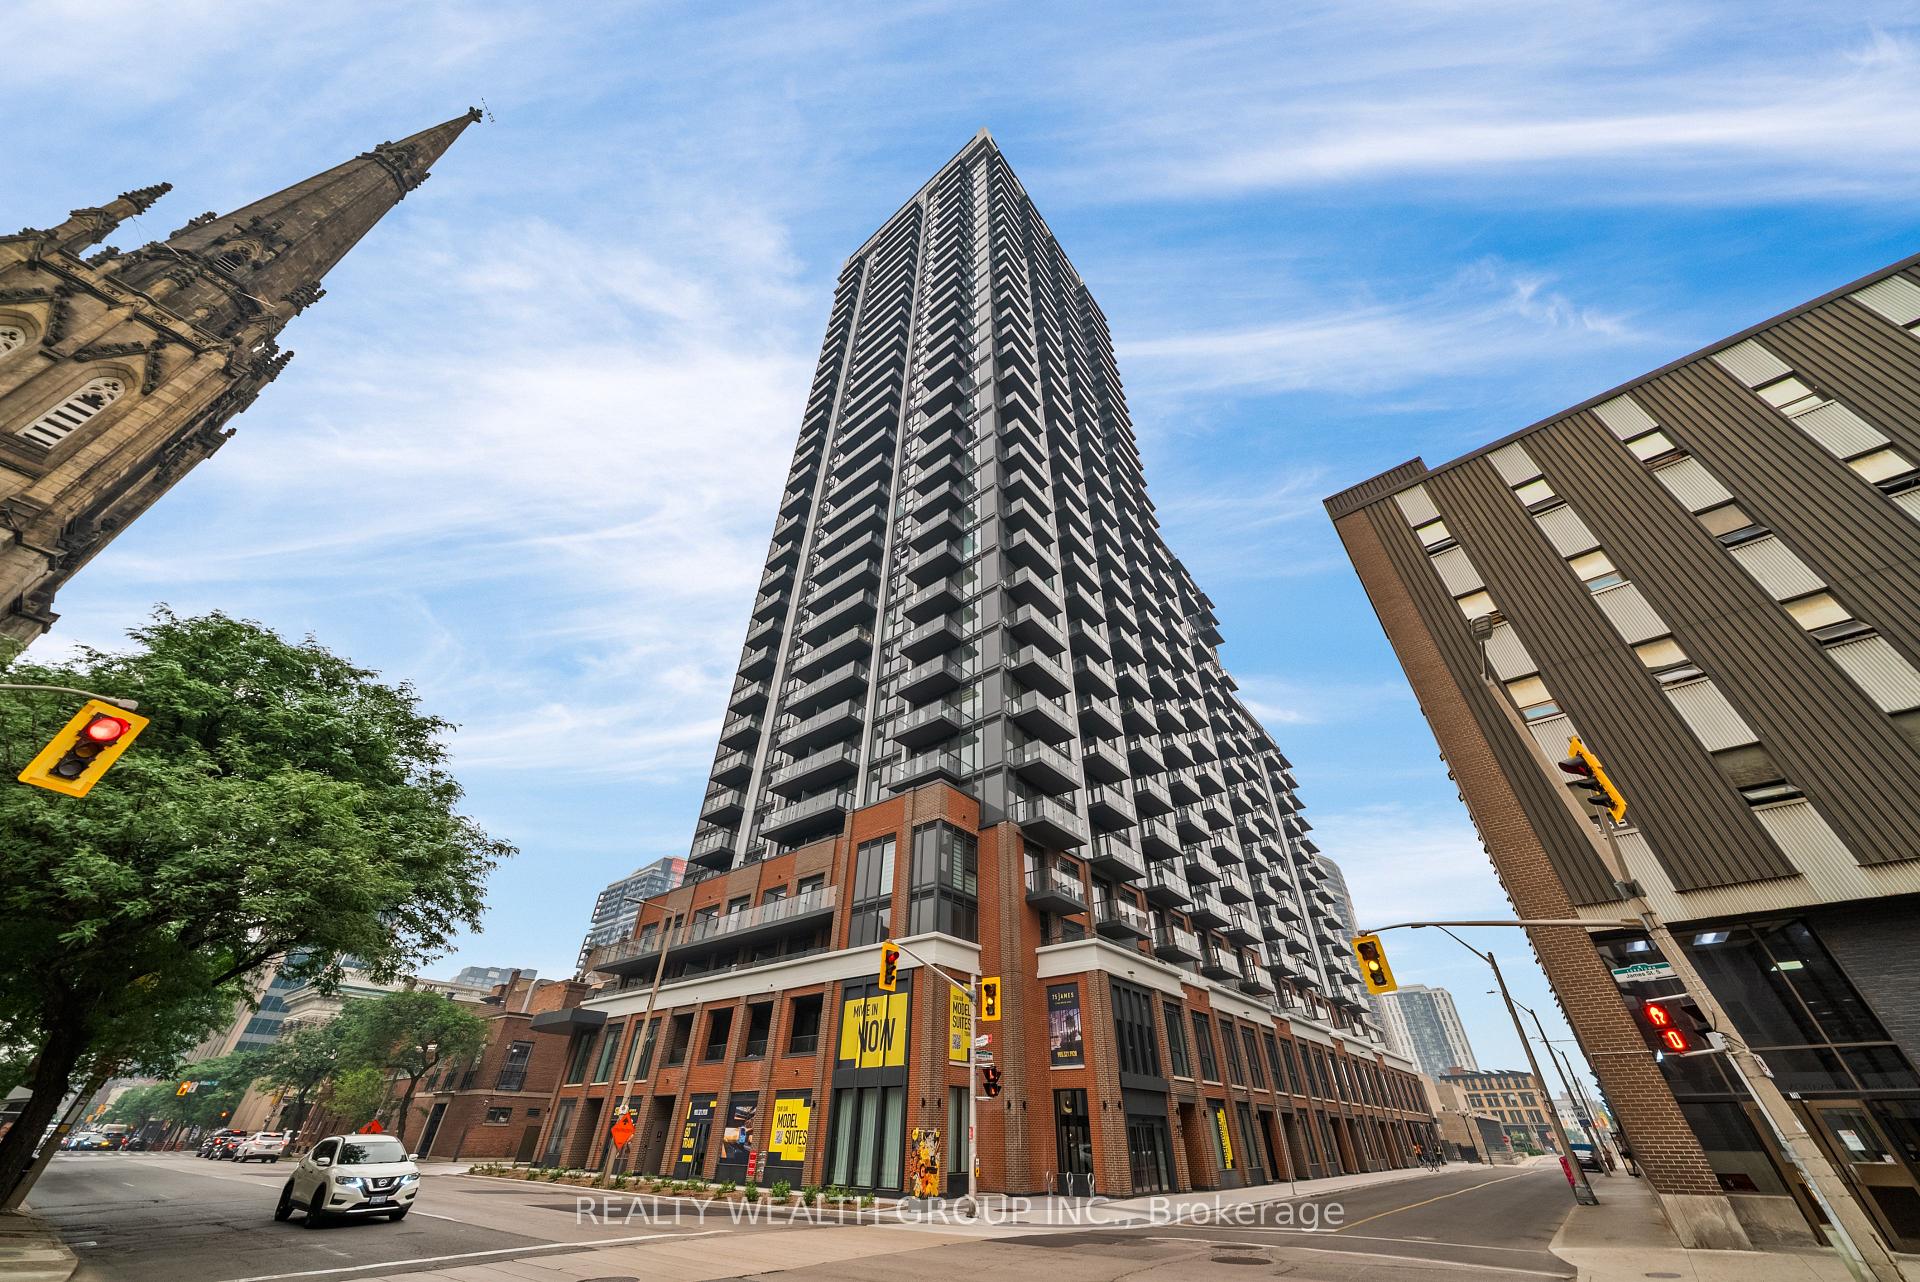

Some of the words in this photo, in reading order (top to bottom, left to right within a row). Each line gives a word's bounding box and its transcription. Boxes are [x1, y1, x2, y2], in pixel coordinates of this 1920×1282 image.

[872, 1003, 879, 1015] IN
[953, 1001, 971, 1016] MODEL
[953, 1015, 971, 1031] SUITES
[858, 1017, 896, 1052] NOW
[776, 1113, 799, 1128] MODEL
[784, 1130, 808, 1145] SUITES
